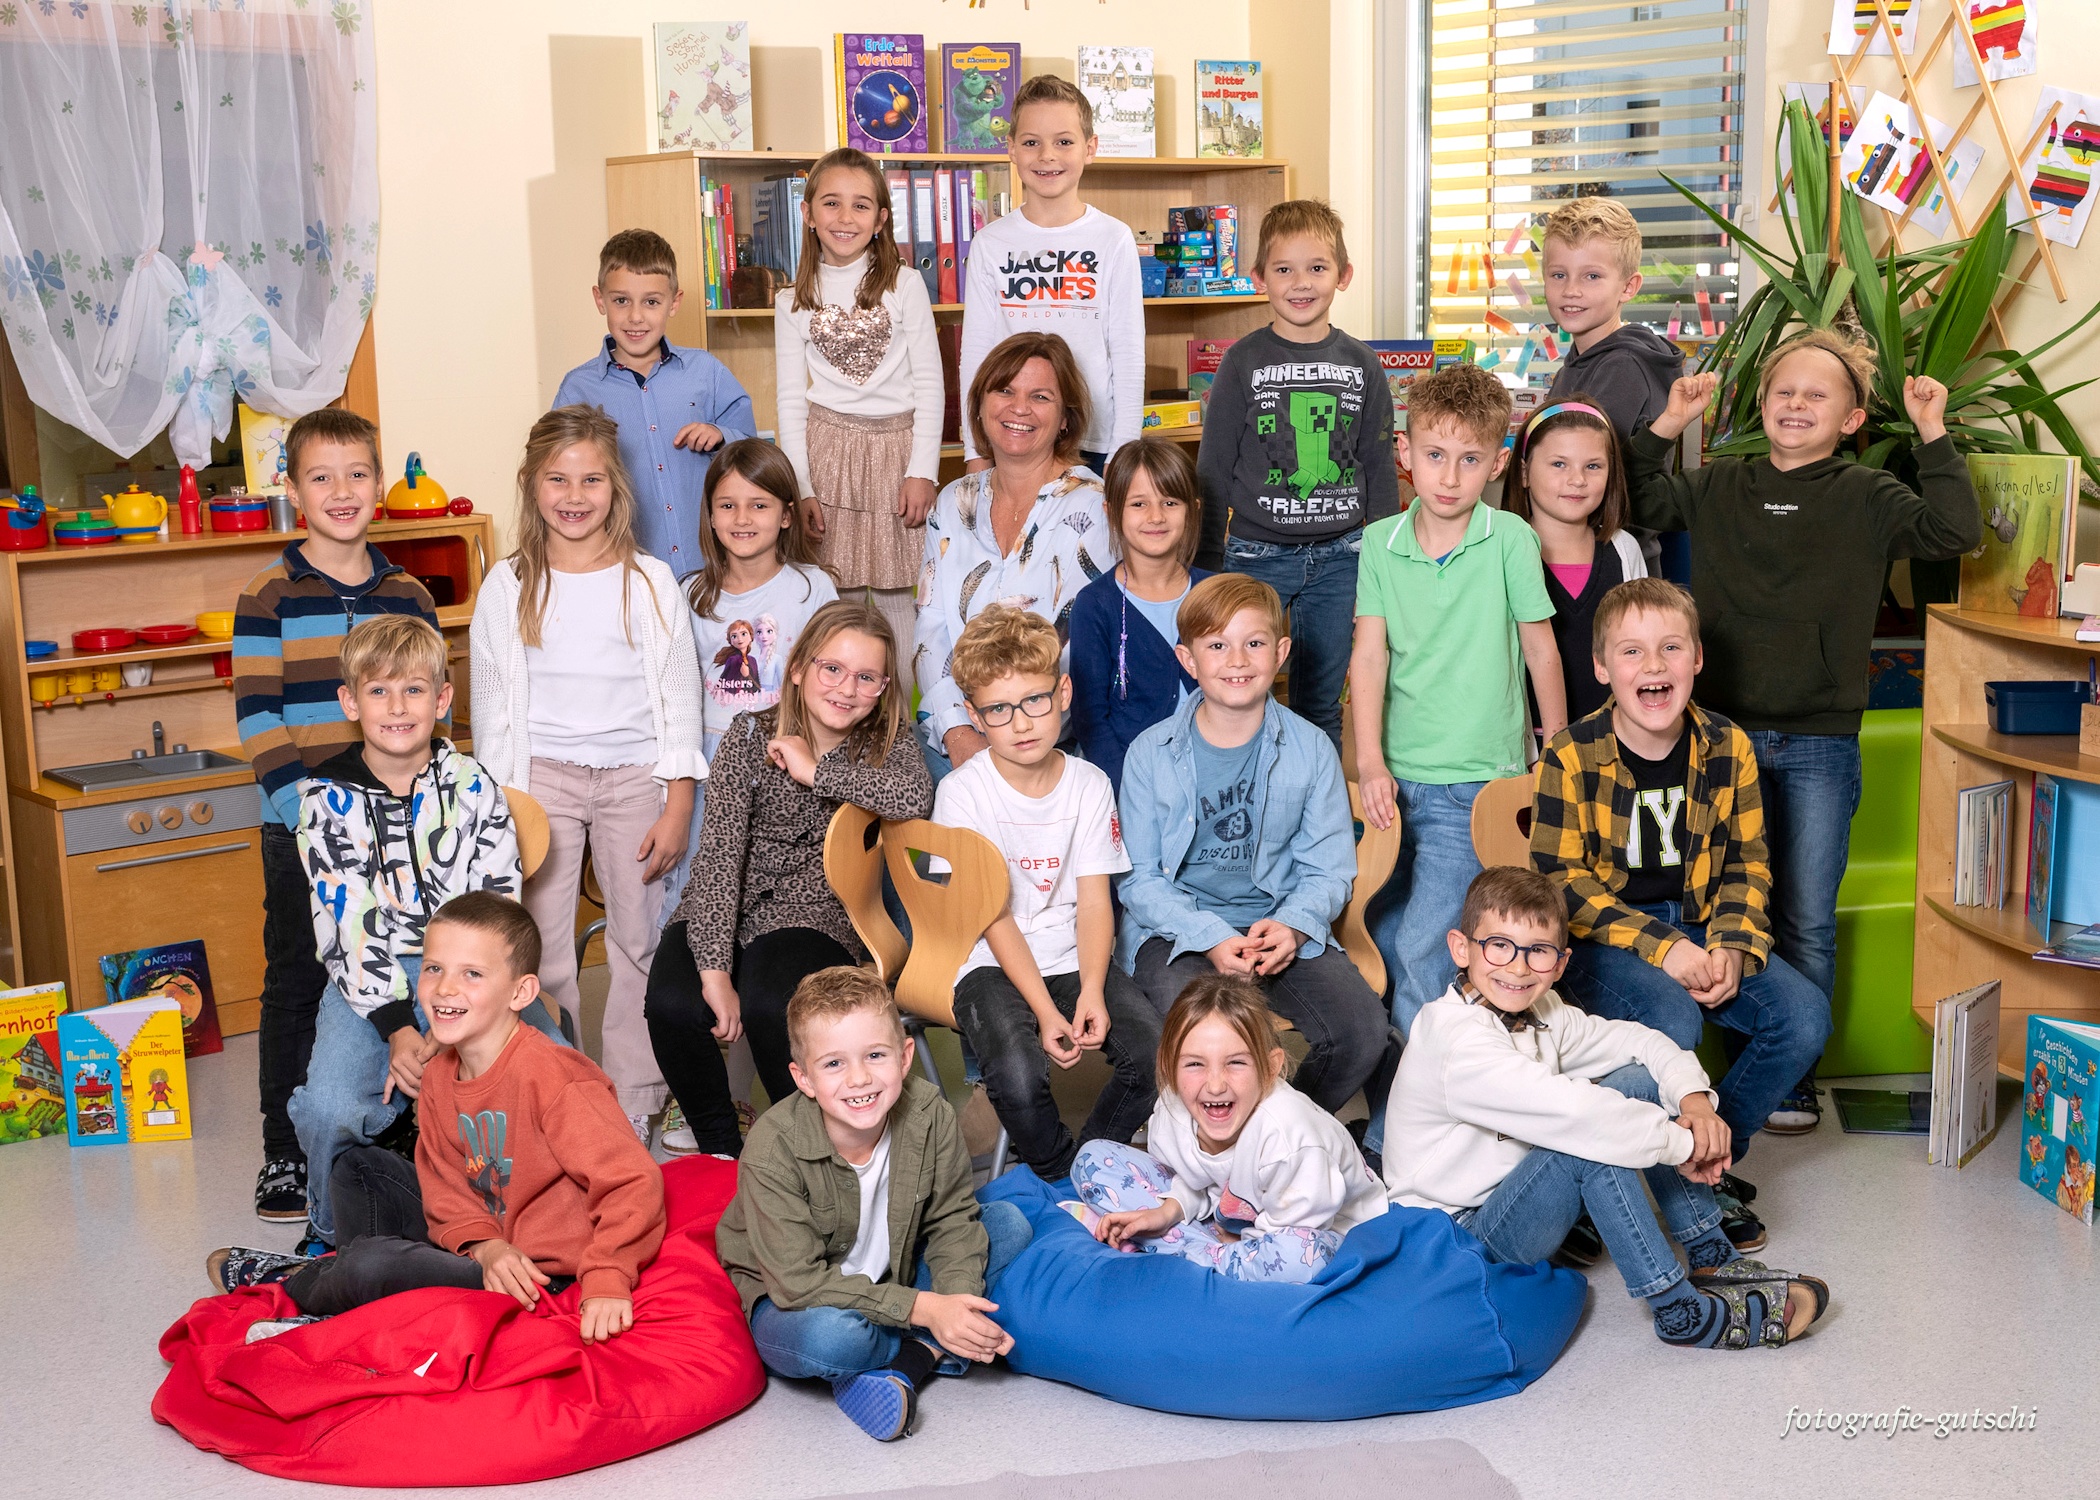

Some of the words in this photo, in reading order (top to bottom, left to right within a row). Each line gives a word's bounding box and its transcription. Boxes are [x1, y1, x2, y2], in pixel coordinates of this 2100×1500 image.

[666, 33, 695, 56] Sieben
[677, 31, 710, 59] Semmel
[864, 37, 895, 52] Erde
[673, 46, 706, 76] Hunger
[856, 52, 912, 67] Weltall
[1214, 75, 1245, 85] Ritter
[1201, 89, 1221, 98] und
[1222, 89, 1258, 101] Burgen
[999, 249, 1099, 274] JACK&
[999, 276, 1097, 300] JONES
[1008, 311, 1099, 319] ORLDWIDE
[1378, 354, 1432, 367] NOPOLY
[1252, 363, 1364, 388] MINECRAFT
[1254, 391, 1280, 401] GAME
[1340, 391, 1362, 403] GAME
[1260, 401, 1276, 410] ON
[1340, 401, 1361, 412] OVER
[1975, 475, 1989, 494] Ich
[1994, 471, 2019, 492] kann
[2022, 474, 2058, 497] alles!
[1313, 487, 1348, 496] ADVENTURE
[1257, 496, 1360, 514] CREEPER
[1763, 502, 1780, 510] Studio
[1780, 503, 1799, 511] edition
[1303, 515, 1313, 523] UP
[1314, 514, 1335, 523] RIGHT
[715, 677, 753, 689] Sisters
[1020, 857, 1060, 870] ÖFB
[150, 1041, 163, 1049] Der
[88, 1049, 110, 1060] Moritz
[132, 1047, 182, 1058] Struwwelpeter
[2045, 1039, 2079, 1066] Geschichten
[2059, 1057, 2065, 1073] 3
[2067, 1065, 2089, 1087] Minuten
